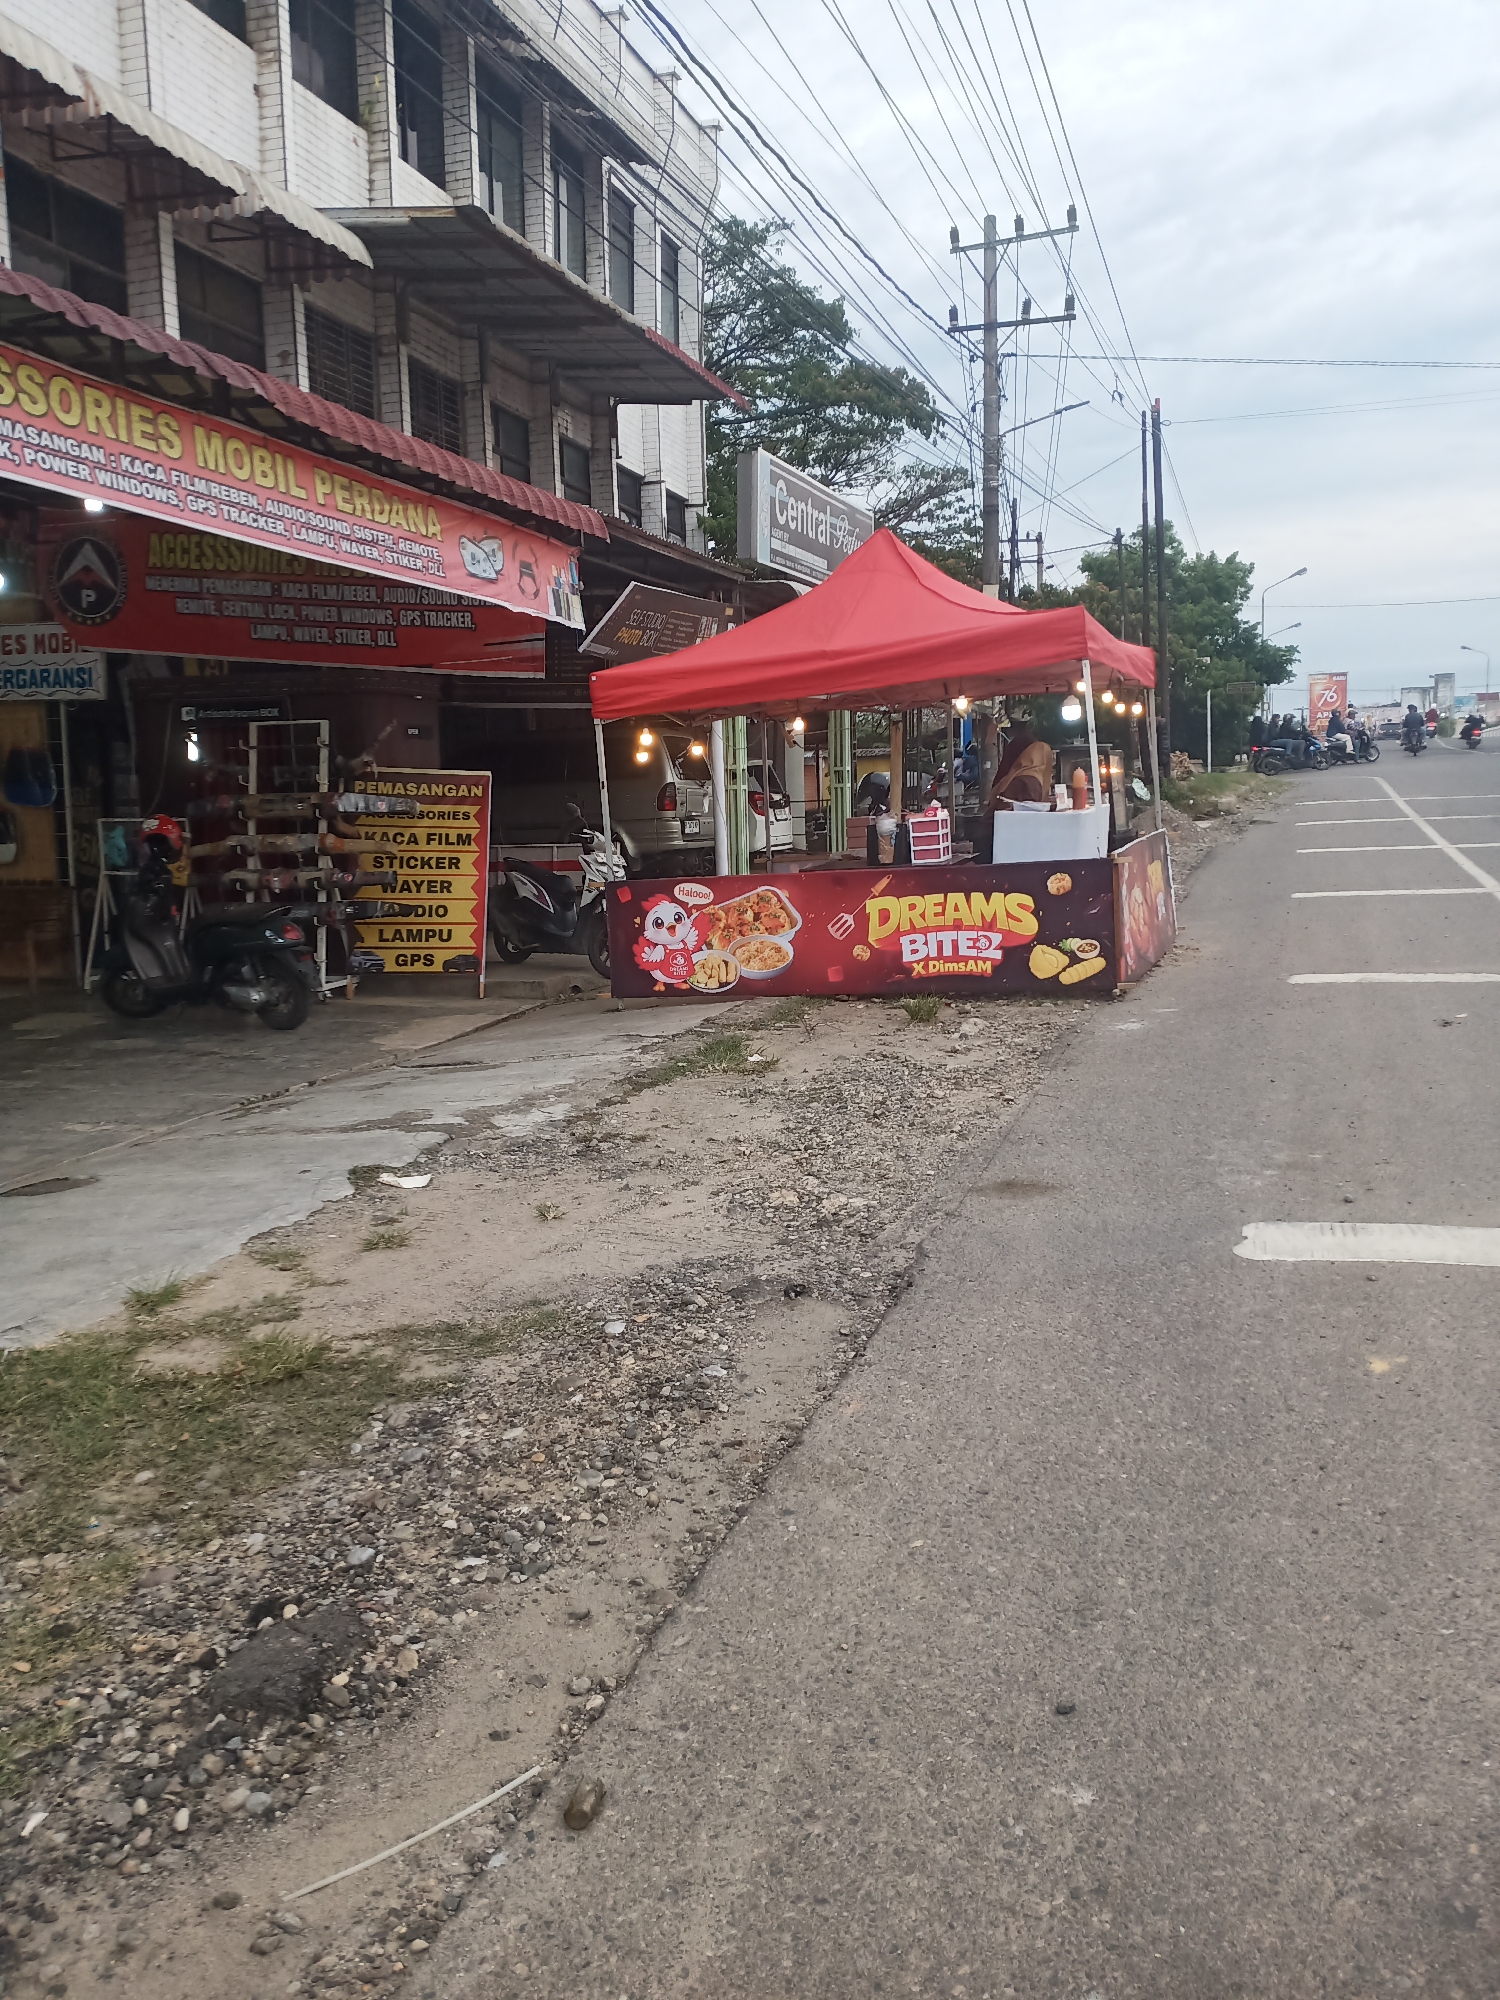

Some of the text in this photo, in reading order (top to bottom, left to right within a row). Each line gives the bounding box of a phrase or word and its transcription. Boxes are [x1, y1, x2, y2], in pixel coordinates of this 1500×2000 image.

[193, 424, 307, 500] MOBIL
[313, 465, 443, 542] PERDANA
[22, 447, 93, 483] POWER
[94, 467, 185, 511] WINDOWS,
[186, 494, 218, 517] GPS
[219, 503, 290, 540] TRACKER,
[292, 523, 339, 553] LAMPU,
[339, 539, 384, 564] WAYER,
[385, 550, 427, 576] STIKER,
[428, 562, 446, 578] DLL
[119, 453, 168, 483] KACA
[265, 499, 351, 535] AUDIO/SOUND
[353, 523, 397, 549] SISTEM,
[398, 538, 444, 563] REMOTE,
[775, 478, 831, 546] Central
[833, 514, 865, 555] Perfu
[81, 589, 97, 609] P
[383, 586, 459, 606] AUDIO/SOUND
[340, 606, 397, 627] WINDOWS,
[399, 609, 421, 627] GPS
[423, 610, 476, 631] TRACKER,
[639, 611, 667, 632] STUDIO
[1, 633, 27, 655] ES
[293, 628, 333, 645] WAYER,
[335, 628, 376, 648] STIKER,
[377, 630, 398, 648] DLL
[613, 626, 643, 646] PHOTO
[640, 629, 660, 648] BOX
[0, 667, 93, 689] RGARANSI
[1317, 684, 1338, 708] 76
[354, 781, 483, 798] PEMASANGAN
[426, 833, 472, 846] FILM
[372, 856, 461, 870] STICKER
[381, 880, 453, 894] WAYER
[678, 886, 711, 900] Halooo!
[865, 892, 1039, 946] DREAMS
[378, 929, 453, 943] LAMPU
[900, 930, 1003, 962] BITEZ
[394, 953, 435, 968] GPS
[928, 960, 992, 974] DimsAM
